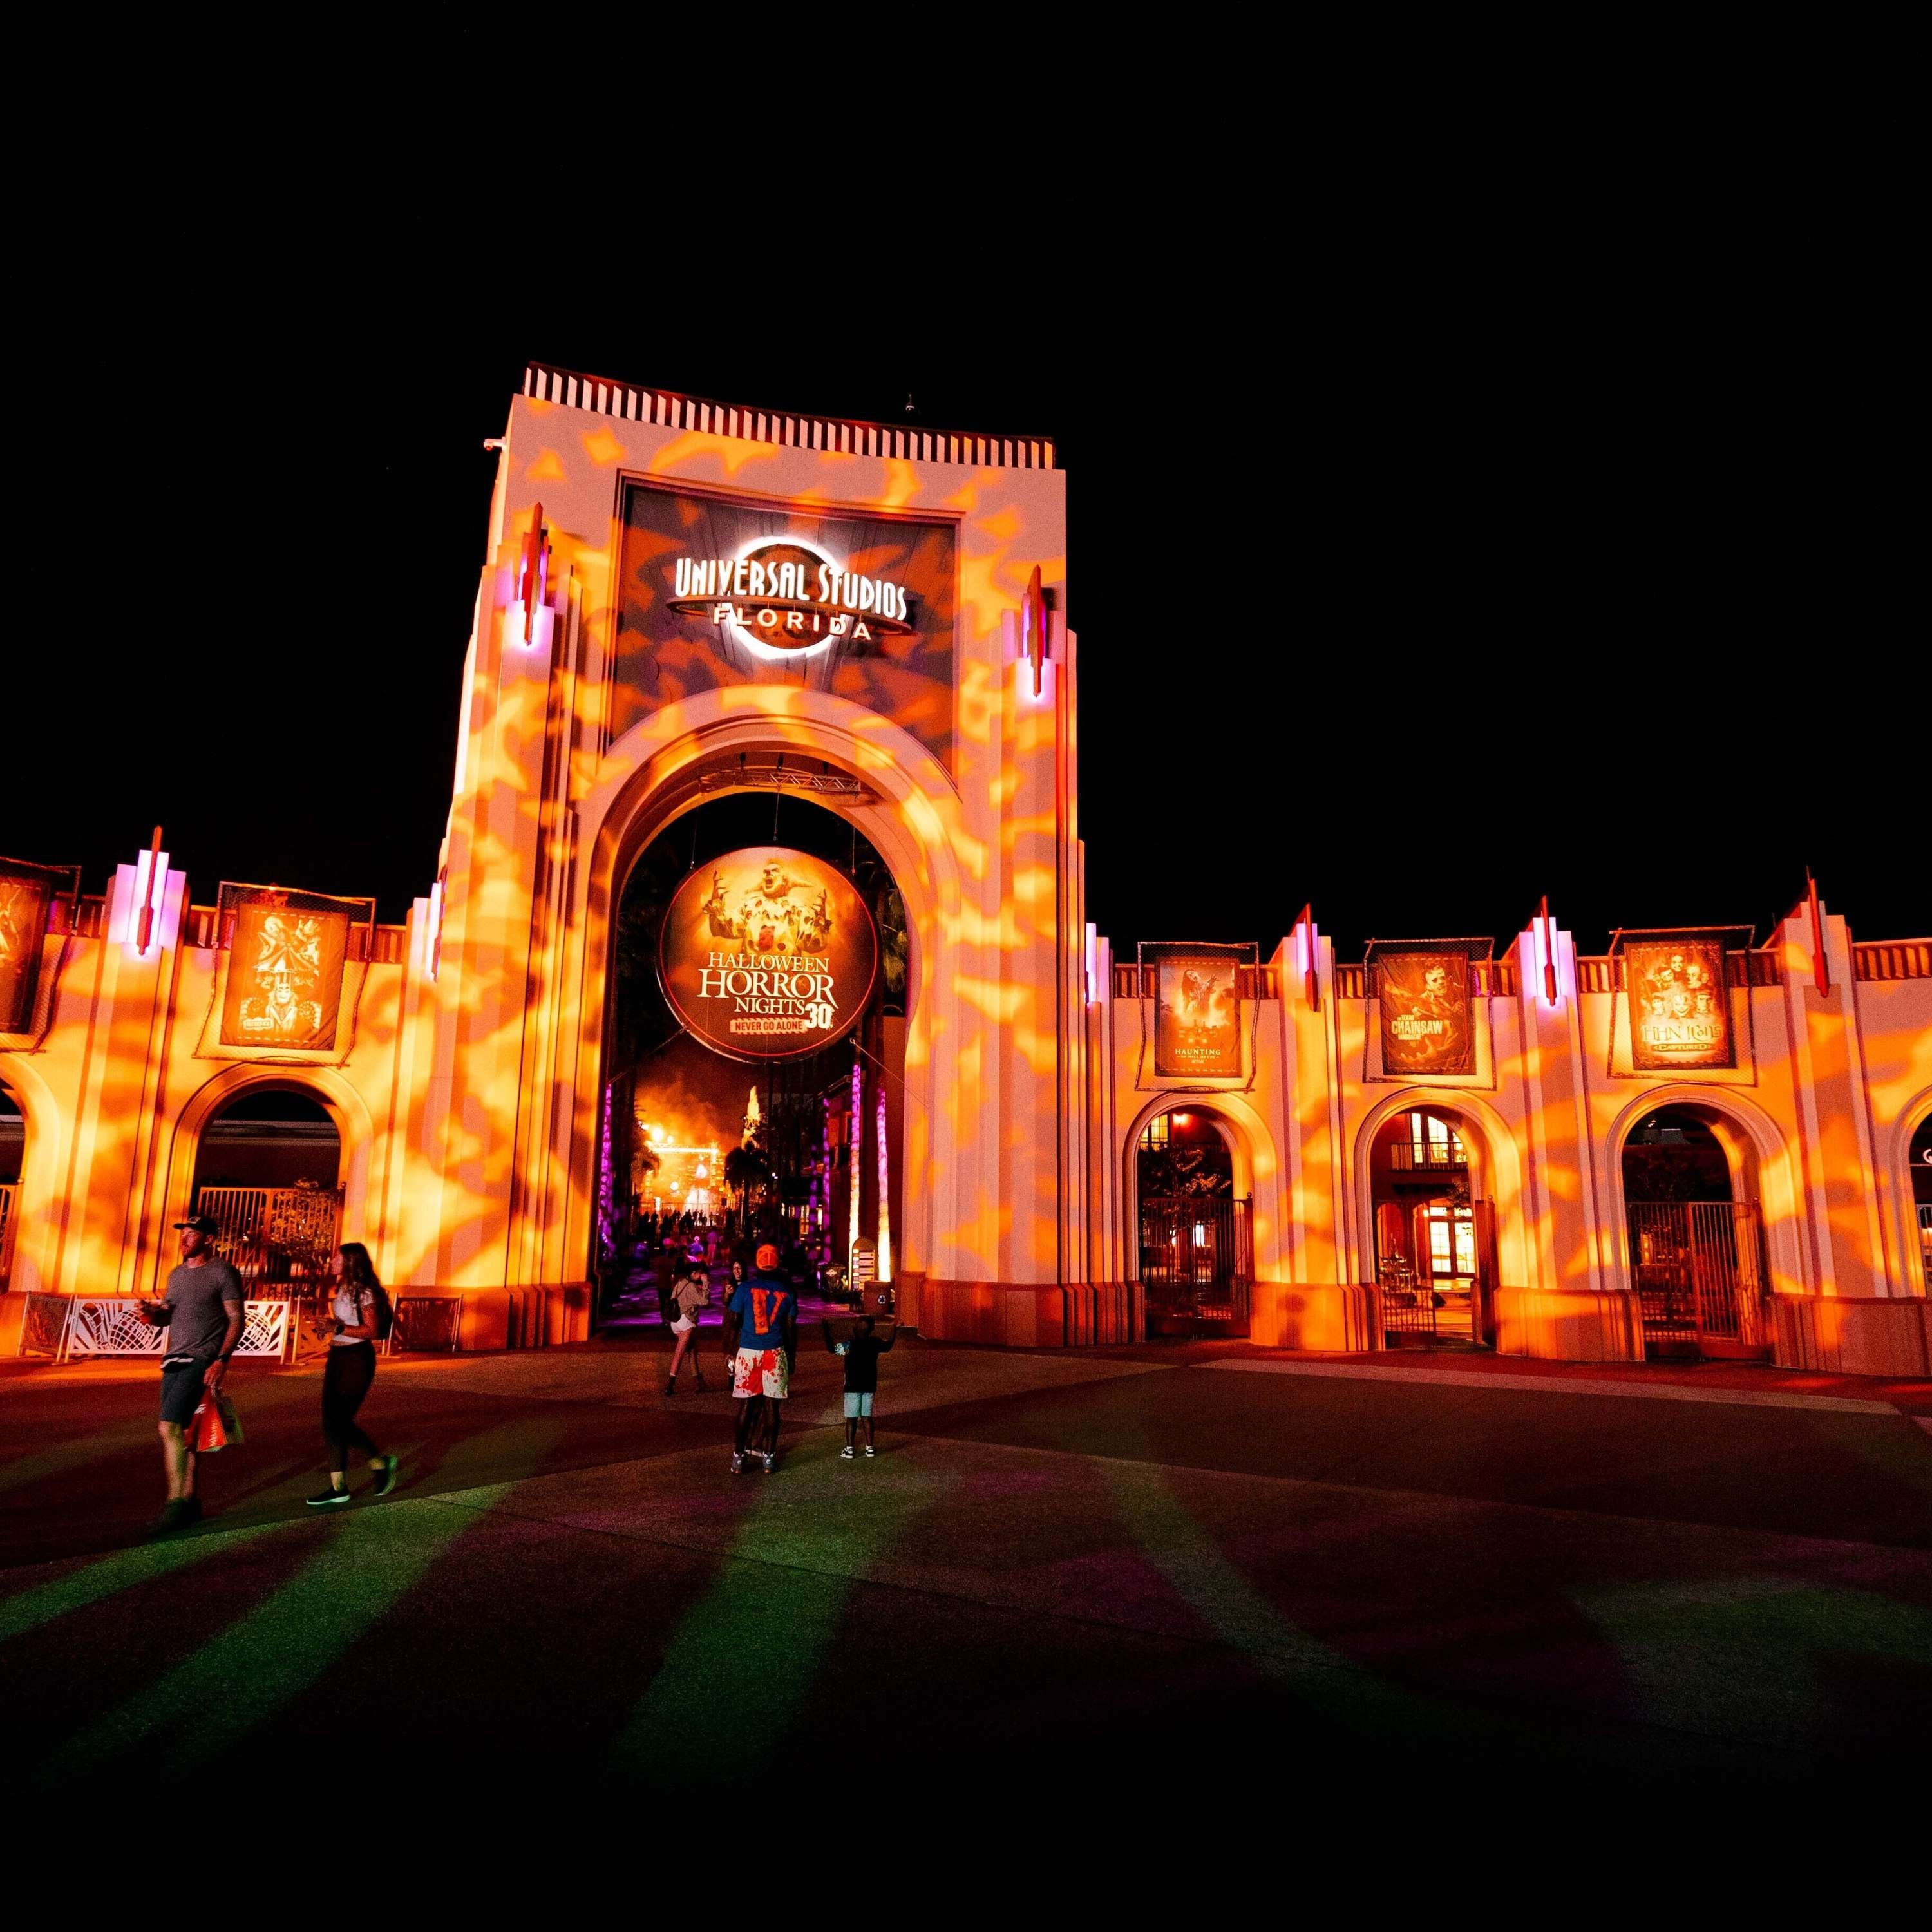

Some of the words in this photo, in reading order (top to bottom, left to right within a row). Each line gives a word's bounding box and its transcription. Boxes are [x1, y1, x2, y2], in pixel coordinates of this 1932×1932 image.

[675, 558, 810, 601] UNIVERSAL
[818, 563, 907, 621] STUDIOS
[714, 607, 871, 641] FLORIDA
[708, 952, 829, 972] HALLOWEEN
[697, 969, 839, 1009] HORROR
[734, 997, 806, 1016] NIGHTS
[805, 1003, 835, 1030] 30
[735, 1021, 762, 1031] NEVER
[763, 1021, 774, 1031] GO
[777, 1021, 802, 1030] ALONE
[1391, 1020, 1443, 1034] CHAINSAW
[750, 1288, 788, 1334] V
